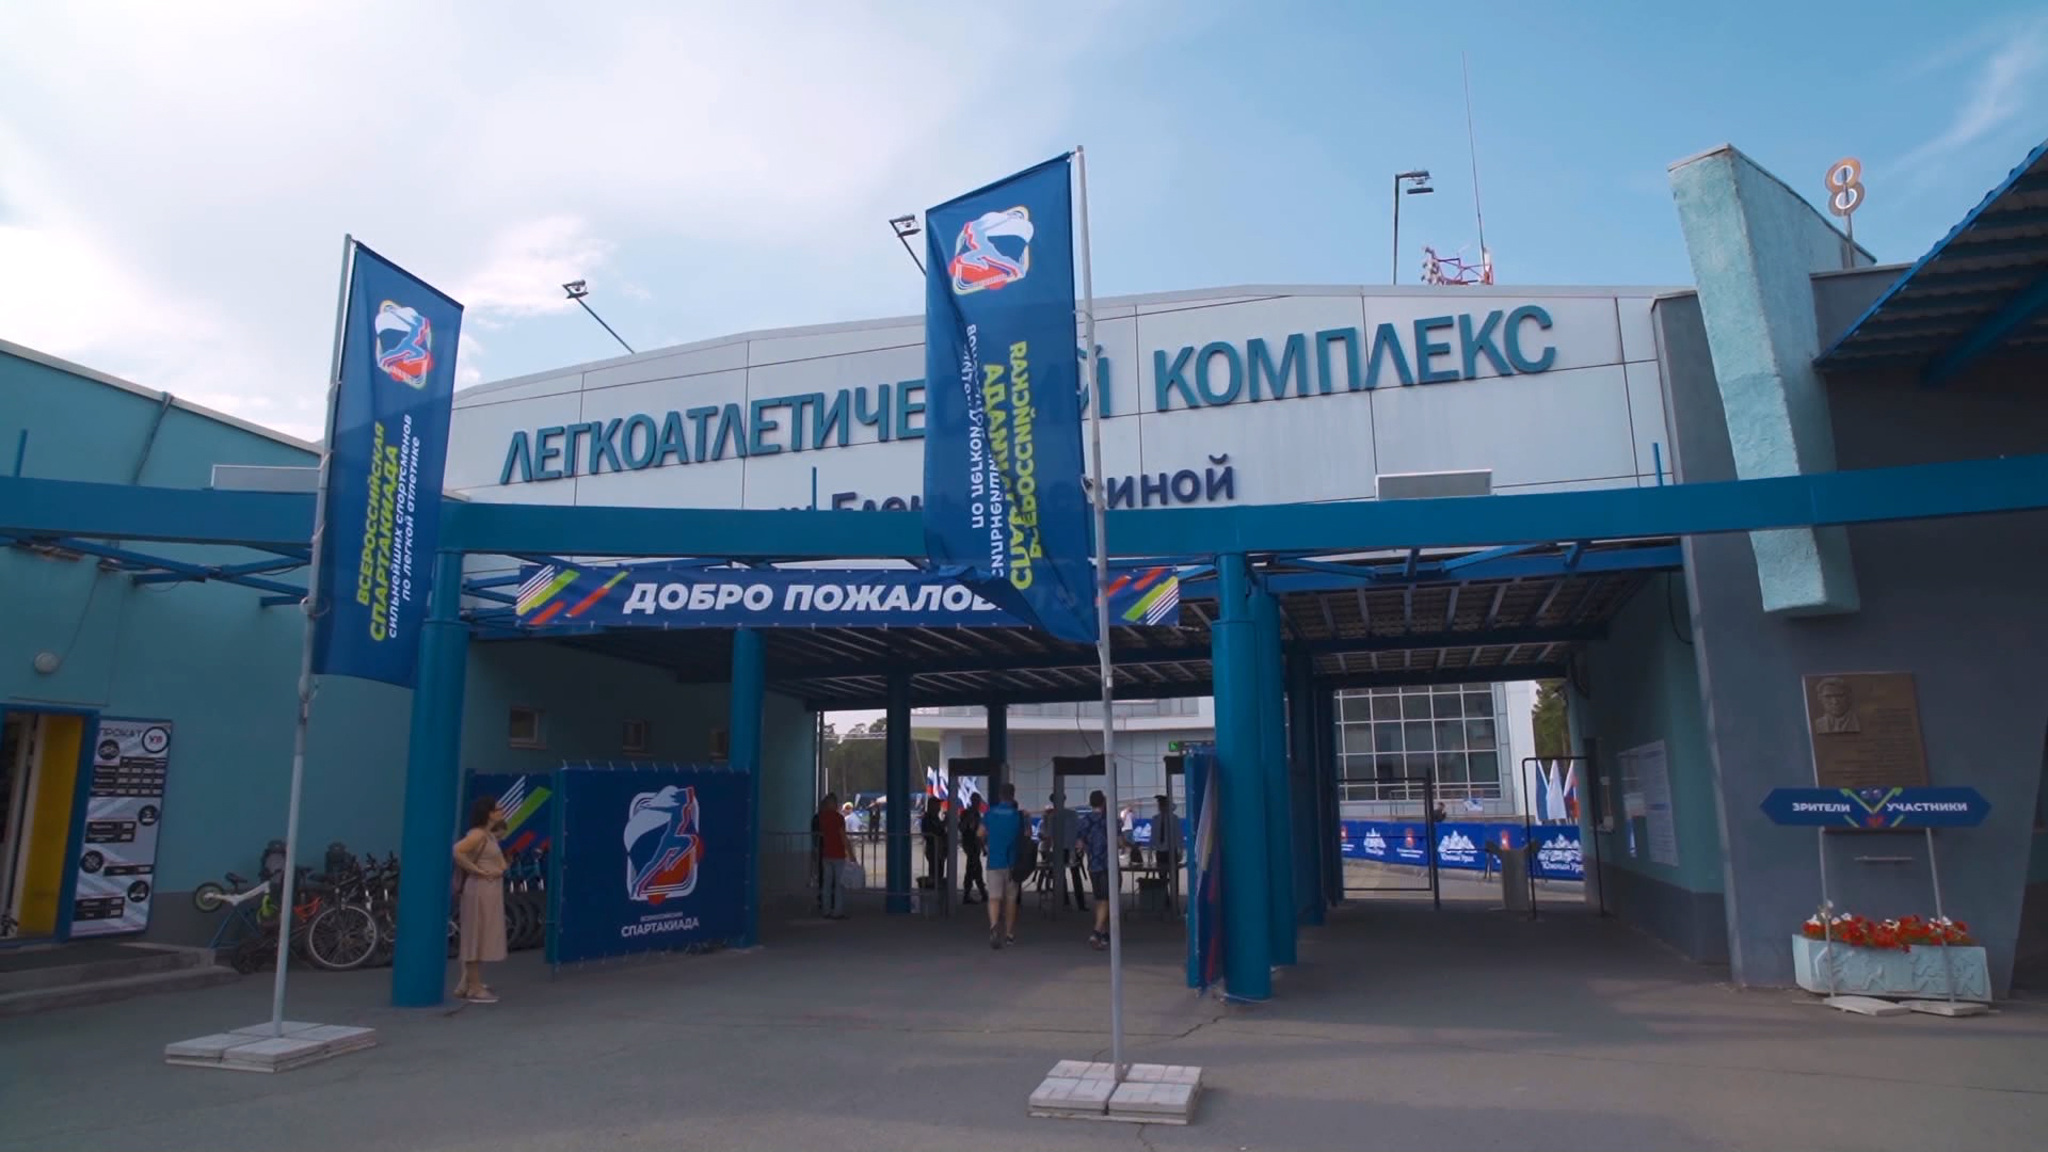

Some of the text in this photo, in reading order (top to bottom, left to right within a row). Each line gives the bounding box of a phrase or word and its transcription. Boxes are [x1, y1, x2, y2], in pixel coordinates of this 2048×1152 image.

[501, 345, 1111, 485] ЛЕГКОАТЛЕТИЧЕЙ
[1153, 304, 1557, 412] КОМПЛЕКС
[356, 421, 385, 606] ВСЕРОССИЙСКАЯ
[370, 445, 399, 641] СПАРТАКИАДА
[623, 583, 774, 615] ДОБРО
[1792, 802, 1967, 812] ЗРИТЕЛИ УЧАСТНИКИ
[621, 917, 699, 937] СПАРТАКИАДА
